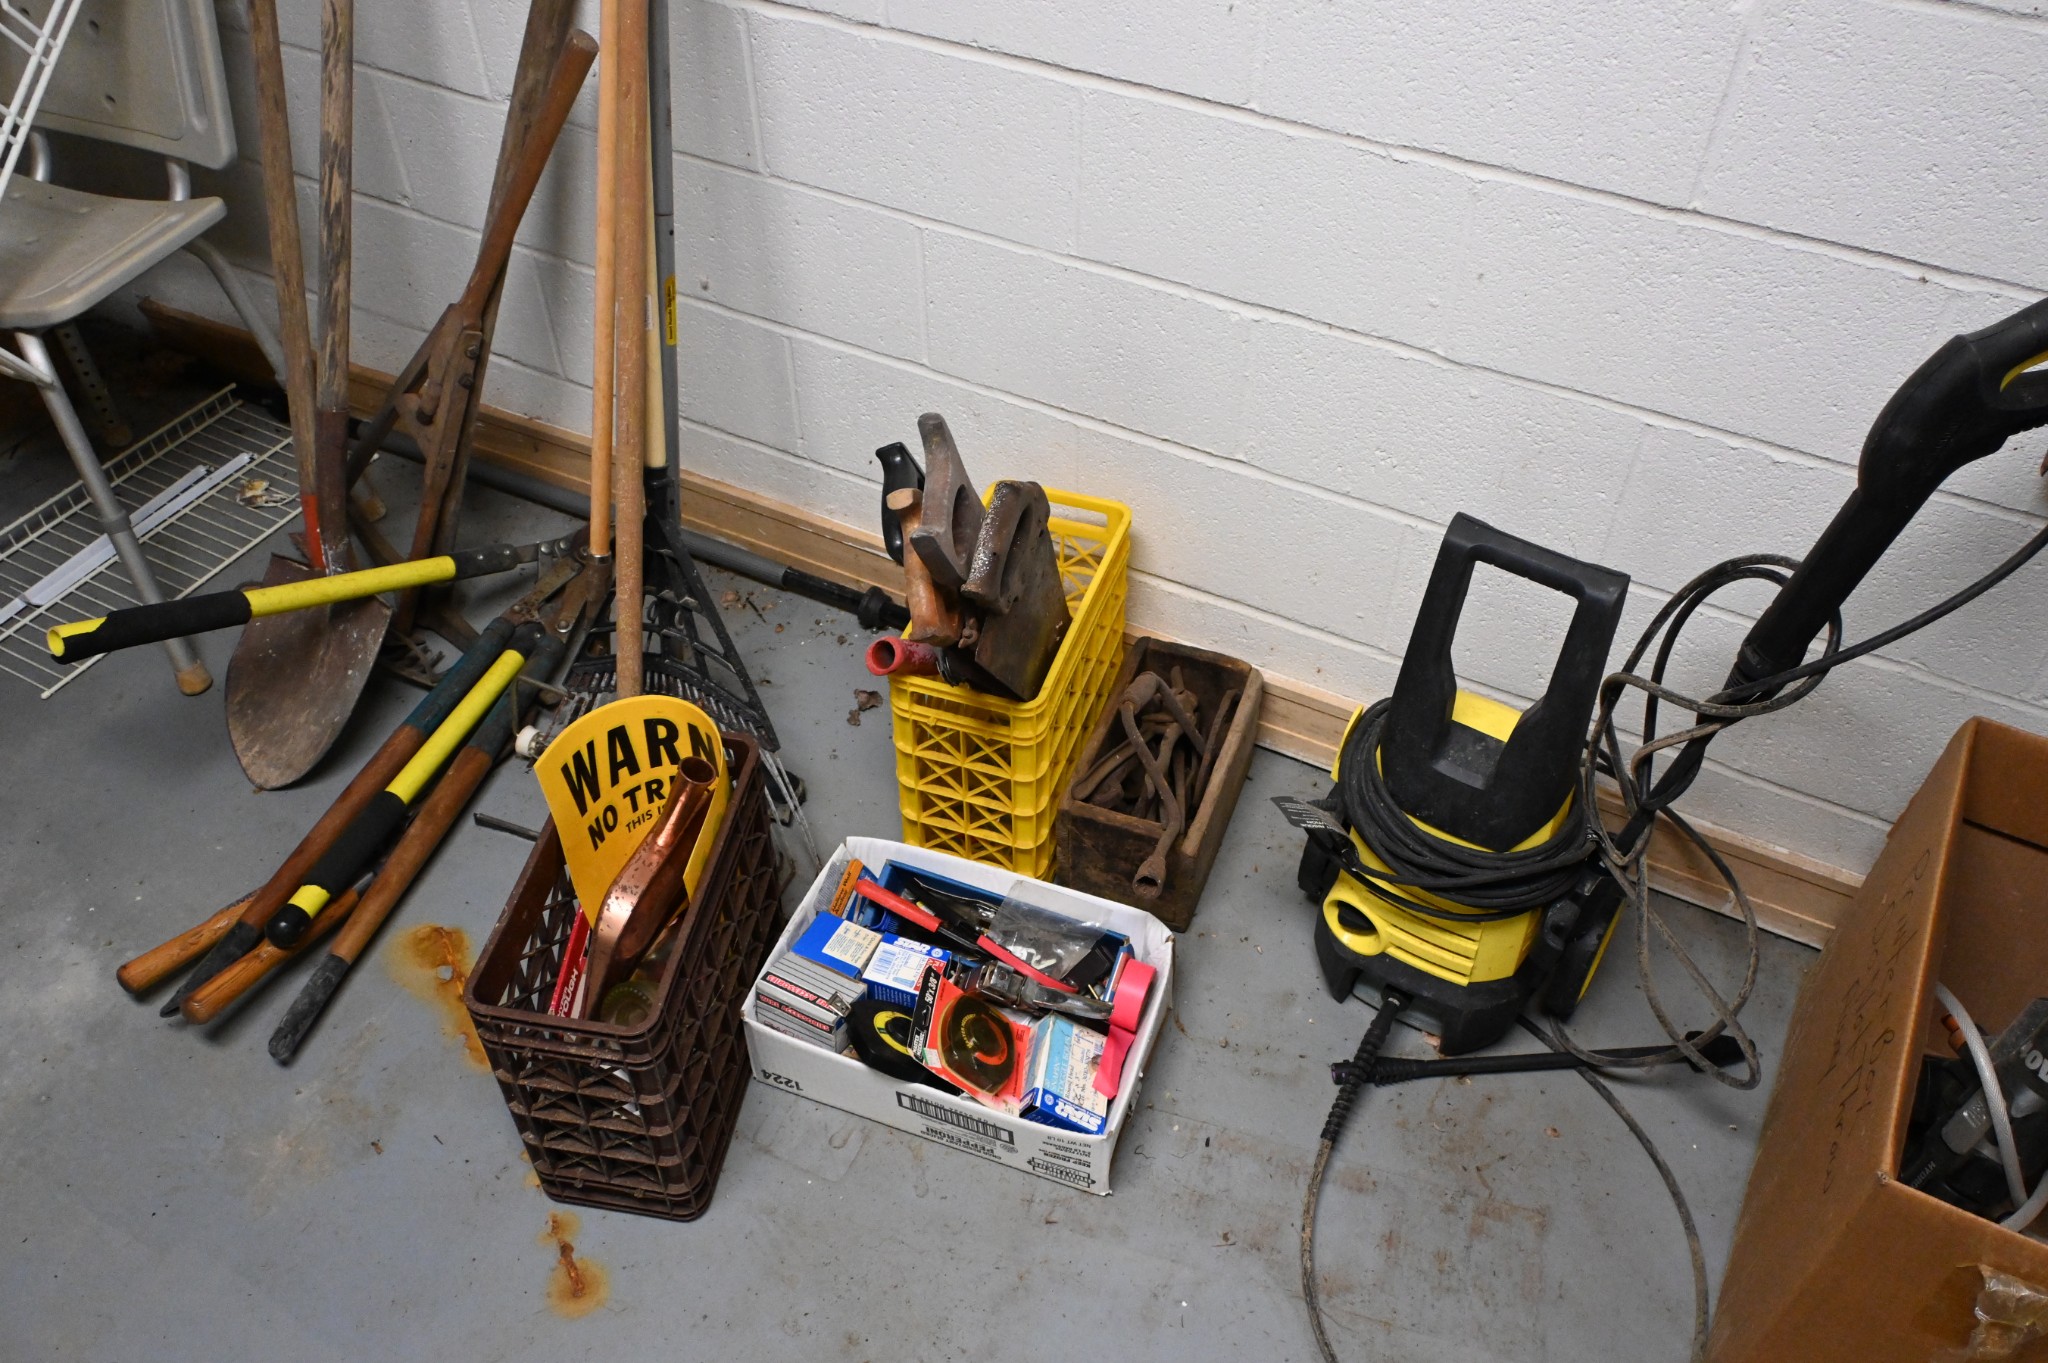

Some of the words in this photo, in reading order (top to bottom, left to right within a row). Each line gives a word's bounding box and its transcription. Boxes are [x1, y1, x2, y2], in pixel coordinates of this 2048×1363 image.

[587, 804, 618, 852] NO
[623, 775, 676, 813] TR
[626, 809, 653, 833] THIS
[657, 804, 665, 815] I
[561, 968, 578, 1017] TOUGH
[766, 974, 818, 1001] ACCESSORIES
[926, 1127, 994, 1154] PEPPERONI
[1044, 1152, 1070, 1162] FROZEN
